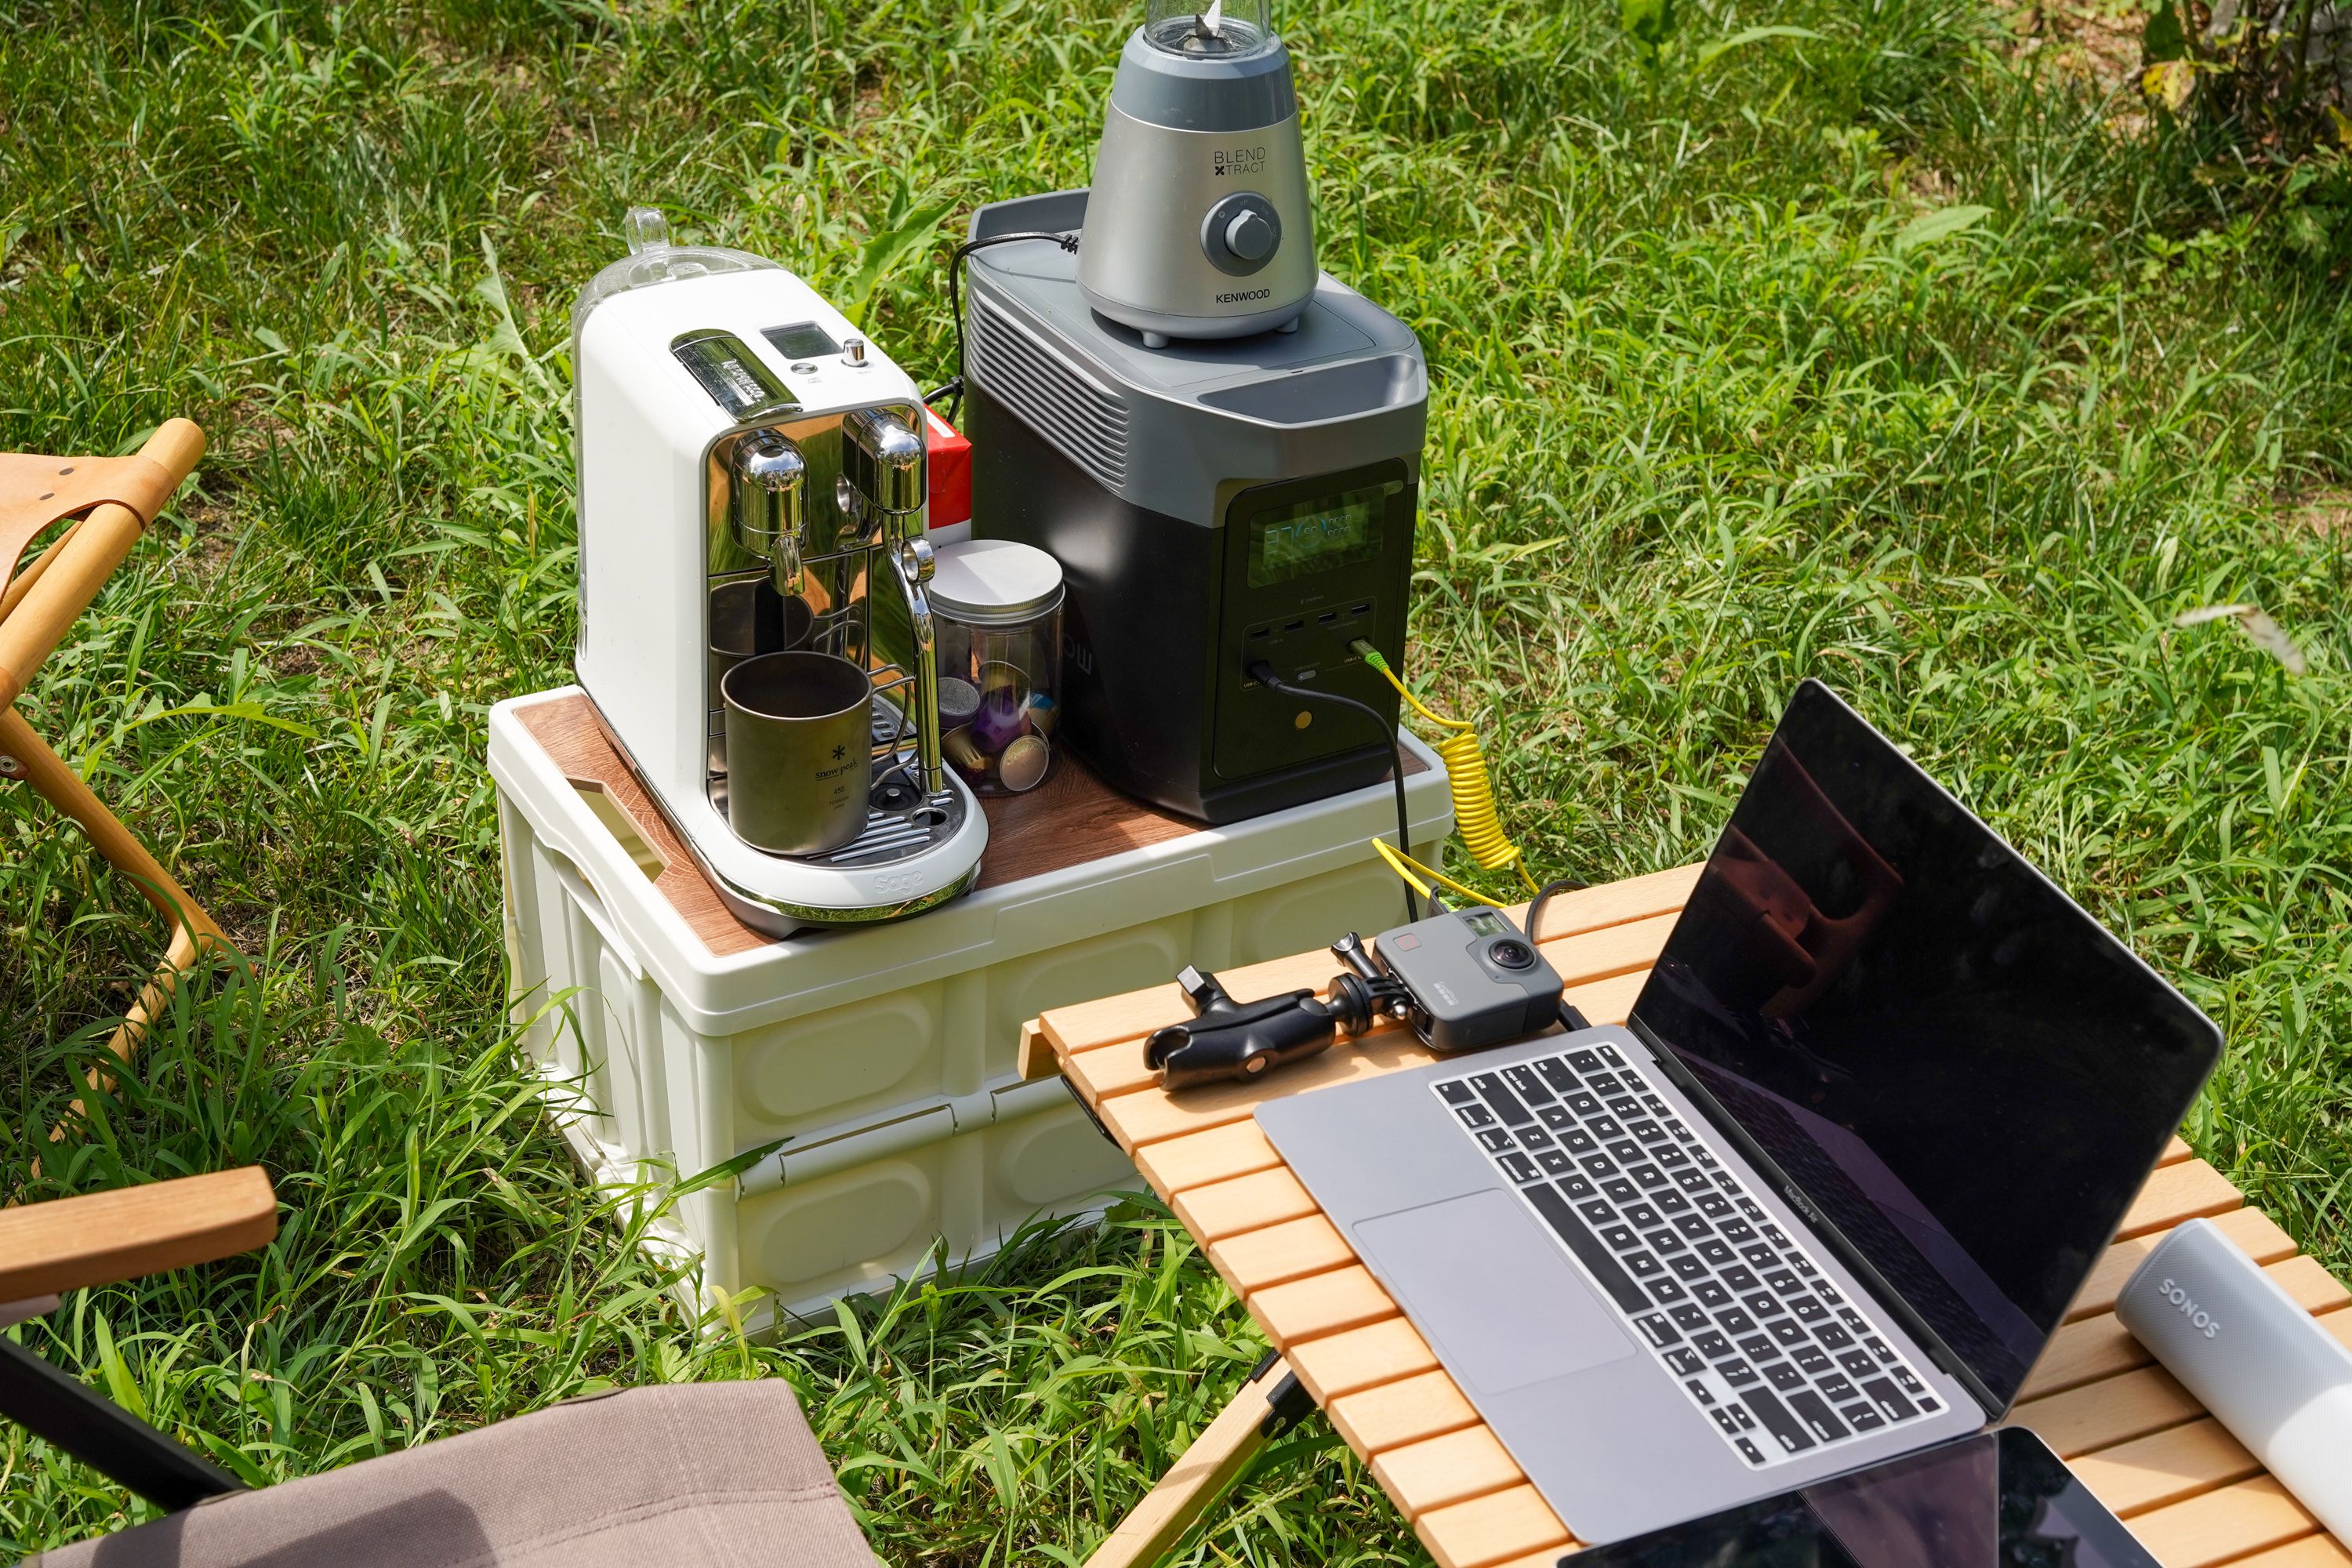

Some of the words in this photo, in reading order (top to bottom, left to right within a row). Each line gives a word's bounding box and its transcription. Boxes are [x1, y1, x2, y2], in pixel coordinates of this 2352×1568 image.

[1214, 147, 1266, 165] BLEND
[1216, 289, 1271, 304] KENWOOD
[815, 768, 840, 779] snow
[840, 757, 858, 775] peak
[833, 786, 845, 794] 450
[873, 870, 924, 895] Sage
[1578, 1099, 1591, 1109] Q
[1616, 1105, 1628, 1113] 2
[1550, 1114, 1563, 1123] A
[1599, 1121, 1613, 1132] W
[1528, 1133, 1542, 1142] Z
[1638, 1128, 1650, 1137] 3
[1572, 1137, 1585, 1145] S
[1621, 1146, 1634, 1156] E
[1548, 1156, 1563, 1167] X
[1661, 1152, 1672, 1161] 4
[1592, 1160, 1606, 1170] D
[1642, 1171, 1656, 1181] R
[1682, 1177, 1694, 1185] 5
[1570, 1181, 1584, 1191] C
[1615, 1185, 1628, 1194] F
[1784, 1185, 1809, 1216] MacBook
[1593, 1206, 1606, 1215] V
[1704, 1202, 1717, 1211] 6
[1637, 1211, 1650, 1221] G
[1688, 1221, 1700, 1230] Y
[1726, 1227, 1740, 1236] 7
[1659, 1236, 1673, 1247] H
[1710, 1247, 1723, 1257] U
[1773, 1279, 1786, 1288] 9
[1659, 1283, 1674, 1295] M
[1704, 1288, 1719, 1299] K
[2158, 1278, 2220, 1339] SONOS
[1729, 1316, 1740, 1326] L
[1780, 1327, 1795, 1337] P
